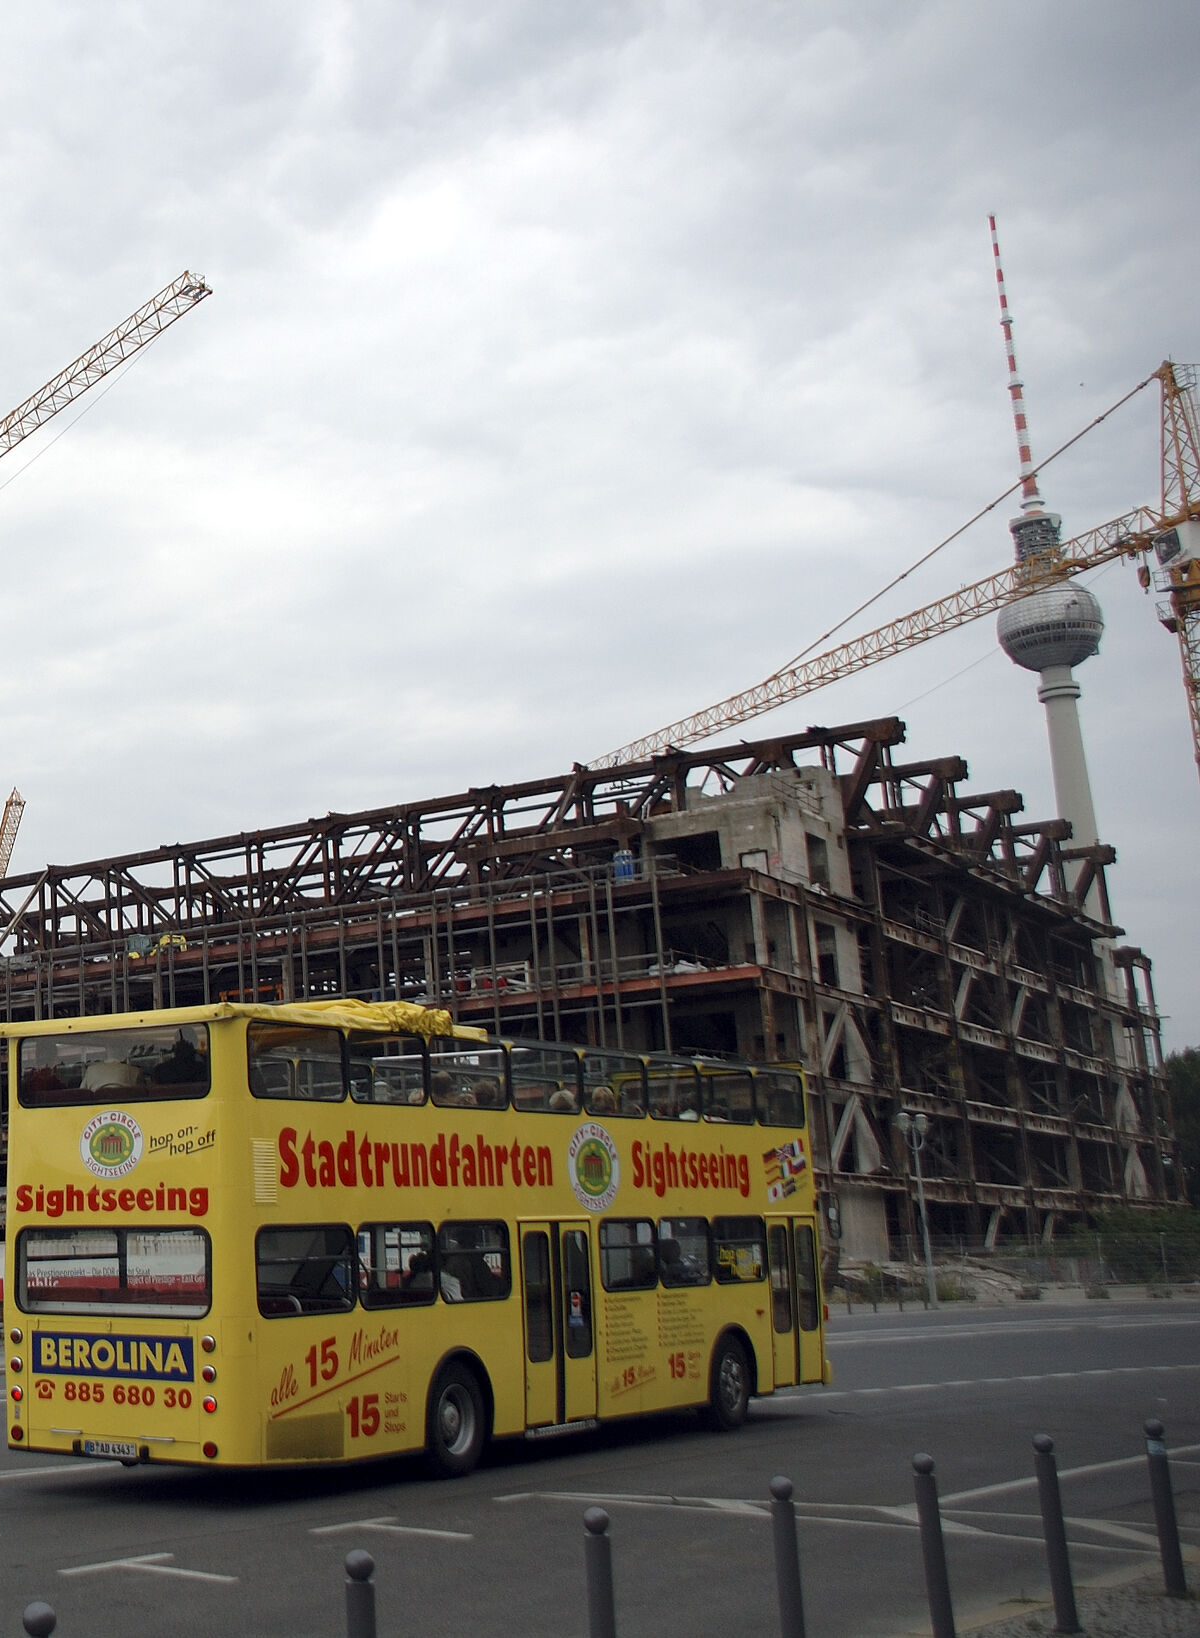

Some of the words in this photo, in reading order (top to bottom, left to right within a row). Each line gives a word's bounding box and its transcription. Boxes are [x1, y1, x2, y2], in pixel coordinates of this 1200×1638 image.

[83, 1112, 141, 1140] CITY-CIRCLE
[149, 1132, 174, 1149] hop
[169, 1140, 194, 1156] hop
[197, 1128, 216, 1146] off
[86, 1156, 138, 1177] SIGHTSEEING
[278, 1126, 554, 1188] Stadtrundfahrten
[631, 1139, 750, 1198] Sightseeing
[15, 1181, 209, 1218] Sightseeing
[40, 1336, 188, 1374] BEROLINA
[271, 1363, 298, 1406] alle
[305, 1336, 339, 1388] 15
[349, 1326, 399, 1371] Minuten
[668, 1352, 686, 1379] 15
[622, 1365, 636, 1387] 15
[64, 1381, 105, 1403] 885
[112, 1384, 156, 1406] 680
[163, 1387, 192, 1409] 30
[346, 1393, 381, 1438] 15
